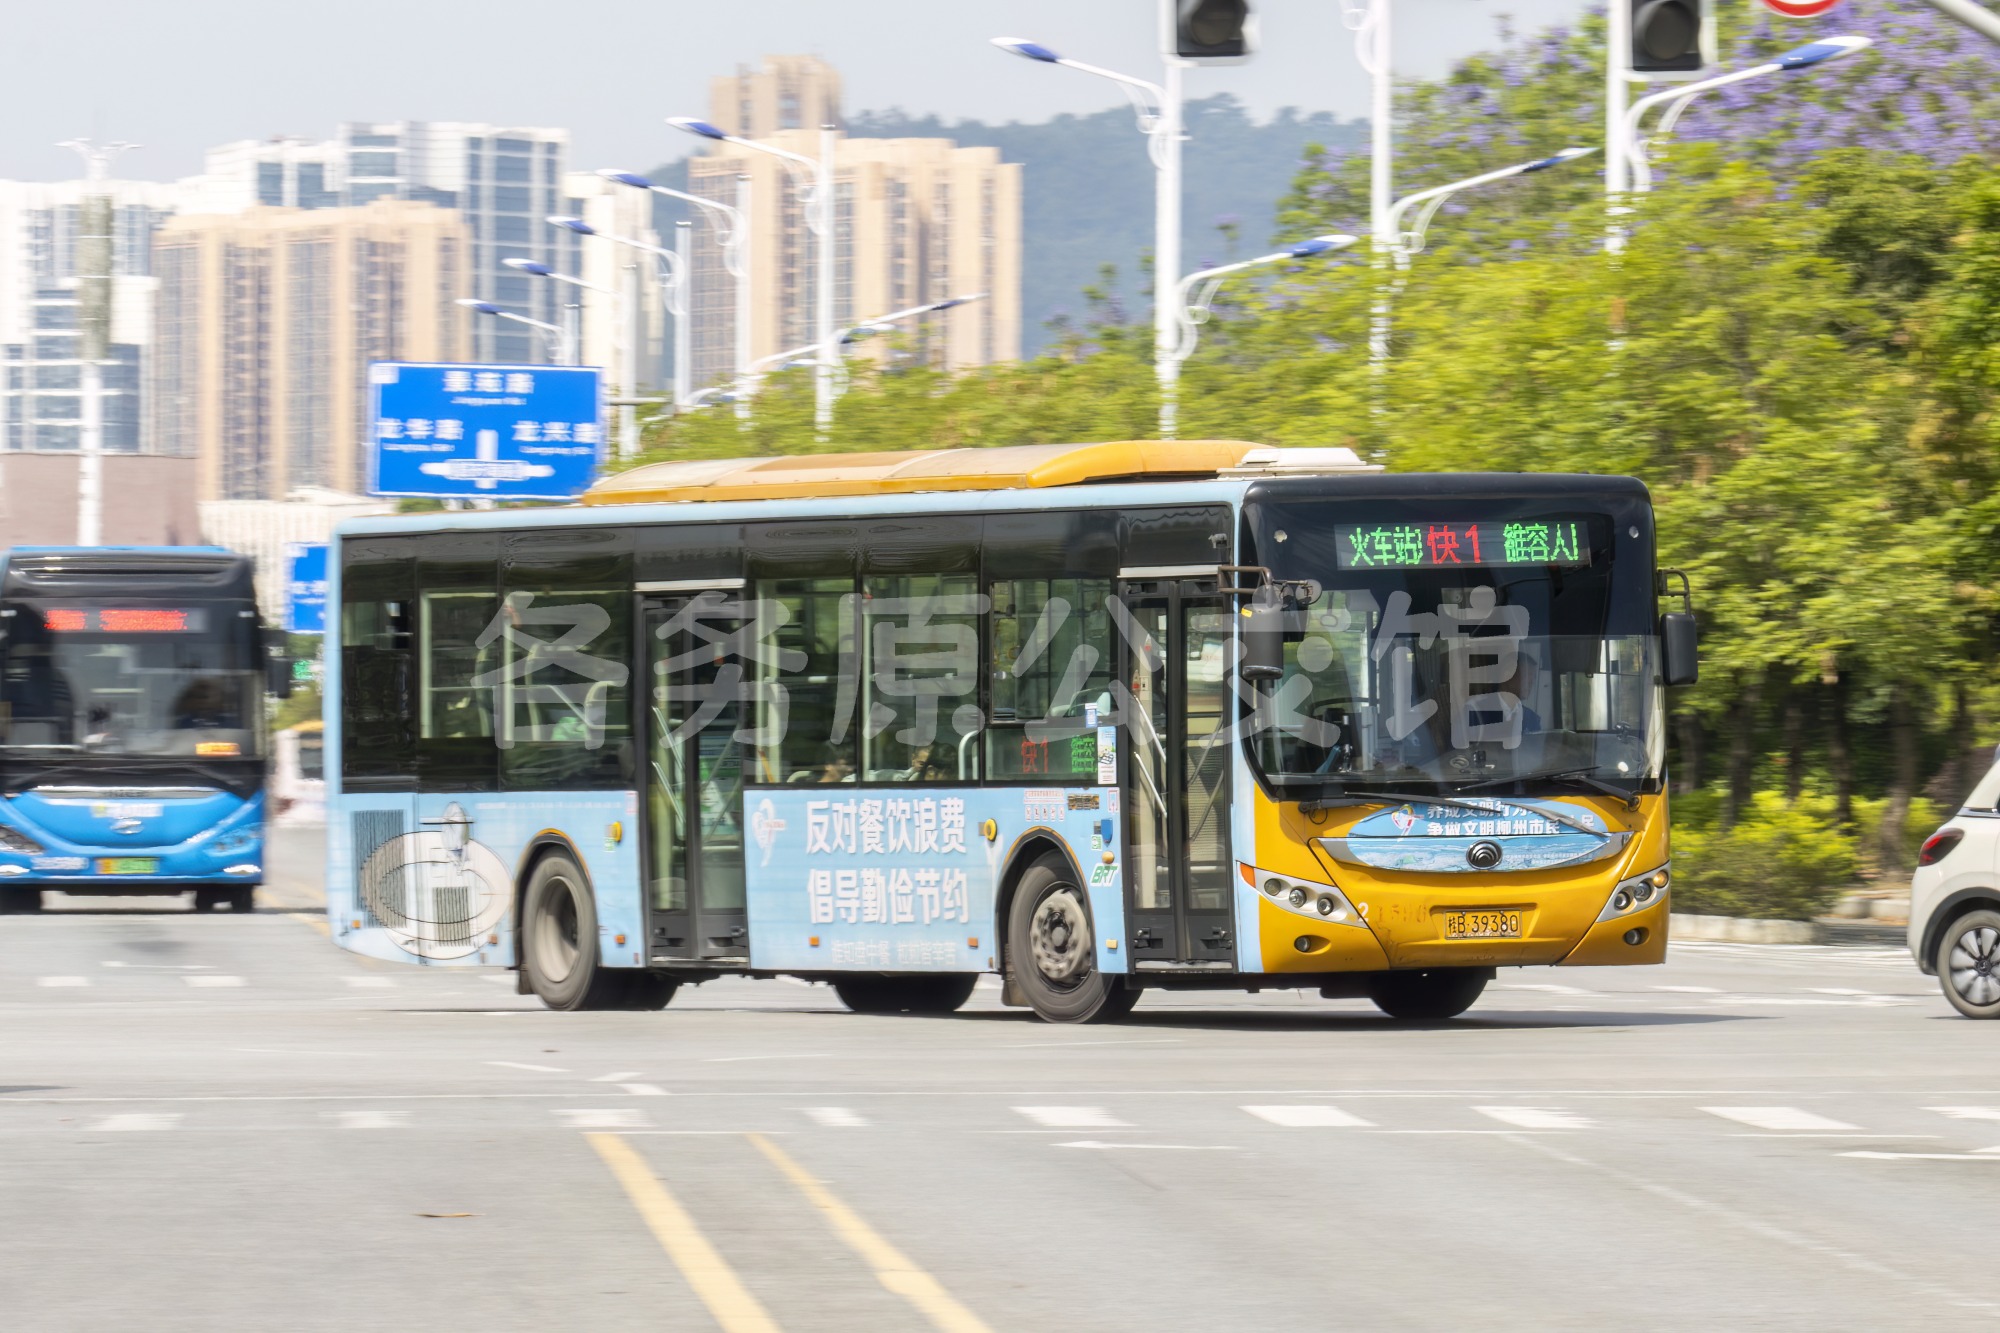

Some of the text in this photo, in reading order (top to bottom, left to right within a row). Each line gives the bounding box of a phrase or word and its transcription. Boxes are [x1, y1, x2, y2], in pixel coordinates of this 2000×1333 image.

[1427, 524, 1481, 564] 快1
[806, 797, 967, 855] 反对餐饮浪费
[807, 867, 970, 925] 倡导勤俭节约
[1091, 865, 1118, 884] BRT
